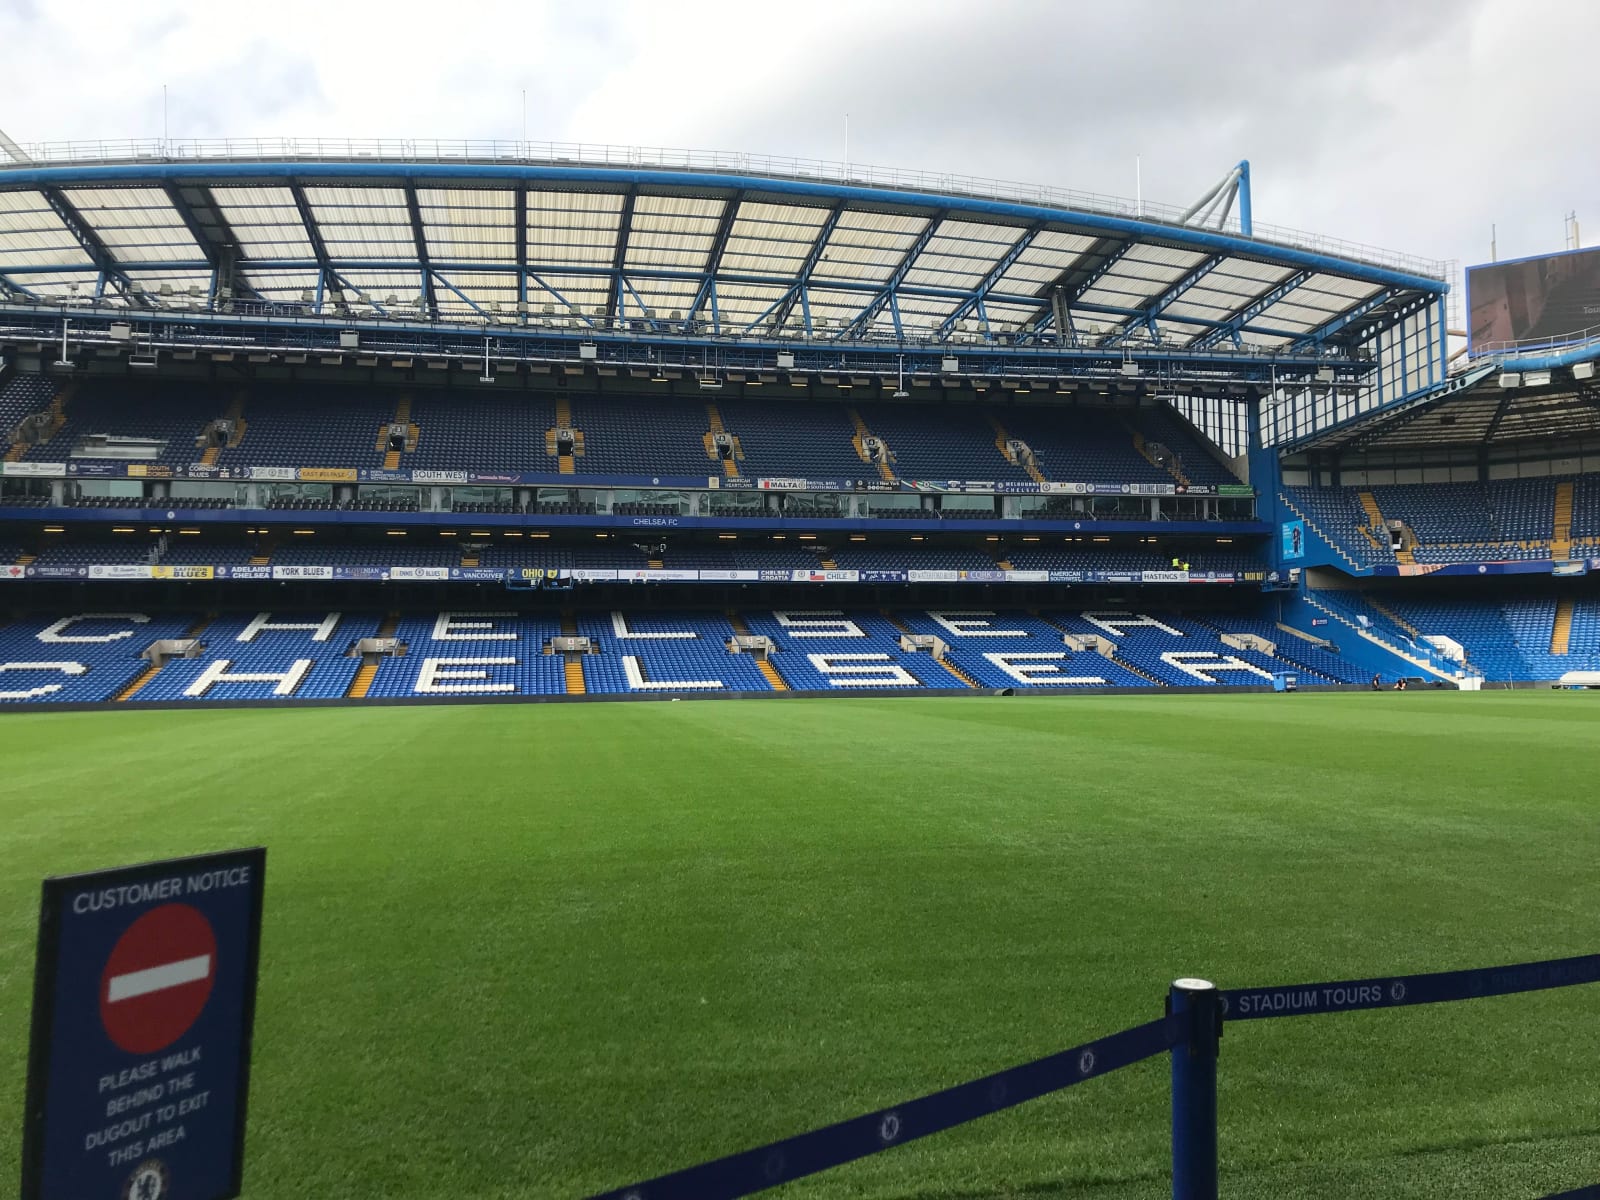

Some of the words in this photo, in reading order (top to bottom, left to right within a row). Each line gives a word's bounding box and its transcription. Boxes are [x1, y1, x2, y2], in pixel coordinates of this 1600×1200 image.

[413, 470, 442, 479] SOUTH
[444, 471, 467, 480] WEST
[633, 518, 667, 526] CHELSEA
[668, 518, 678, 526] FC
[281, 567, 300, 576] YORK
[303, 567, 325, 576] BLUES
[521, 568, 544, 578] OHIO
[826, 571, 848, 580] CHILE
[970, 570, 992, 579] CORK
[1144, 572, 1178, 580] HASTINGS
[72, 877, 182, 914] CUSTOMER
[186, 866, 250, 892] NOTICE
[1239, 990, 1319, 1013] STADIUM
[1322, 985, 1383, 1007] TOURS
[98, 1059, 158, 1094] PLEASE
[162, 1046, 202, 1071] WALK
[106, 1084, 164, 1118] BEHIND
[168, 1071, 195, 1094] THE
[85, 1111, 152, 1151] DUGOUT
[156, 1105, 175, 1124] TO
[178, 1090, 211, 1116] EXIT
[108, 1143, 144, 1168] THIS
[147, 1125, 187, 1153] AREA
